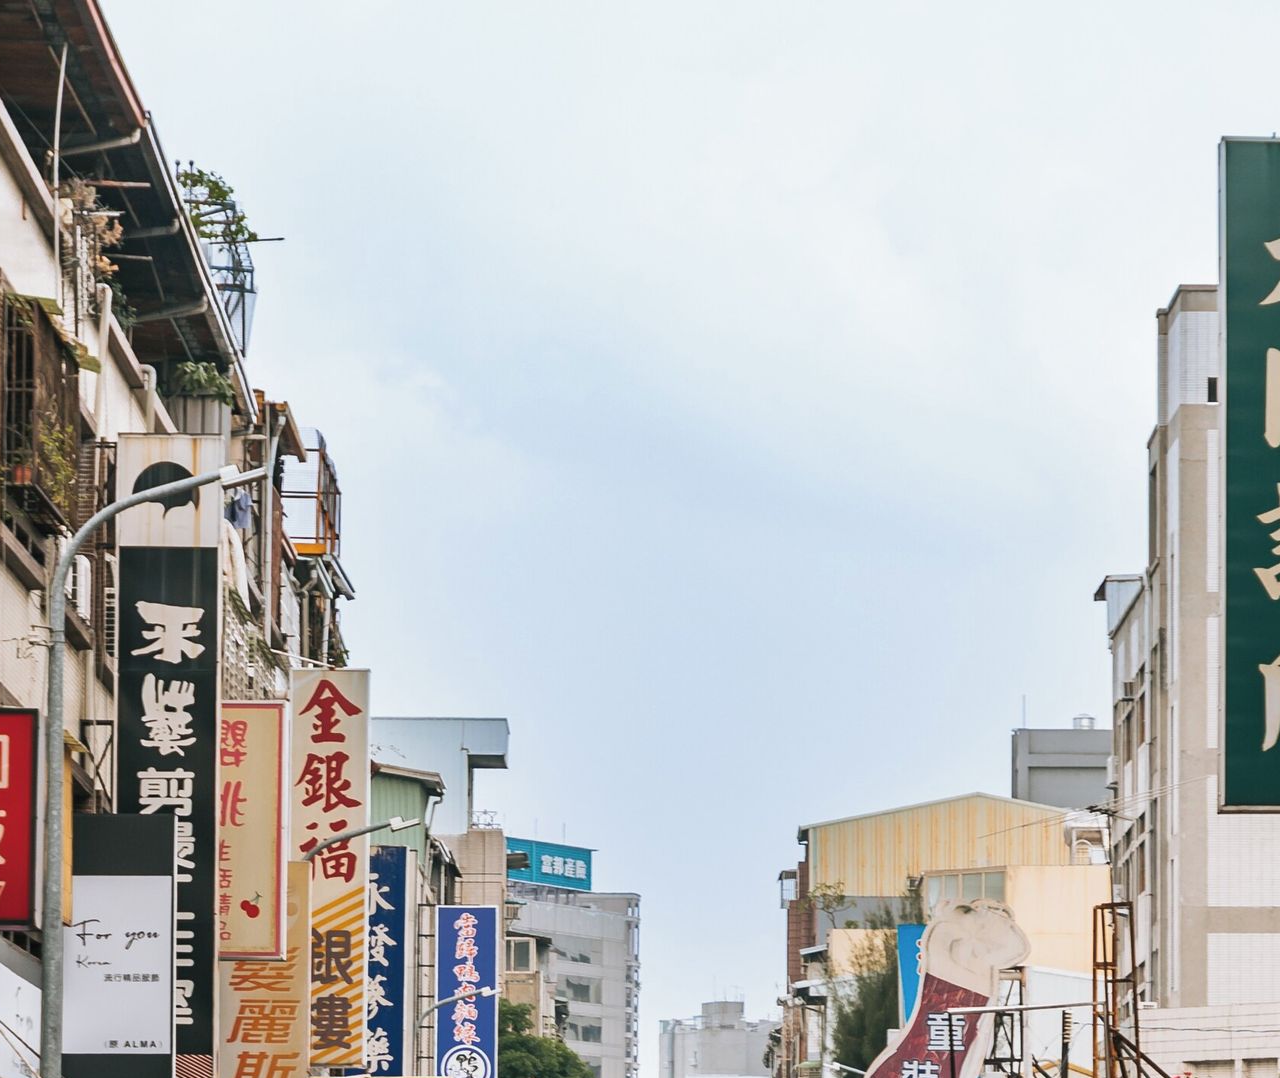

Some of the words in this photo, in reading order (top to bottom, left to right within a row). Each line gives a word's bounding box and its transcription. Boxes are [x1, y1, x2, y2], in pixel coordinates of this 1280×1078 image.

[295, 679, 363, 884] 金銀福
[72, 918, 113, 947] For
[124, 930, 161, 951] you
